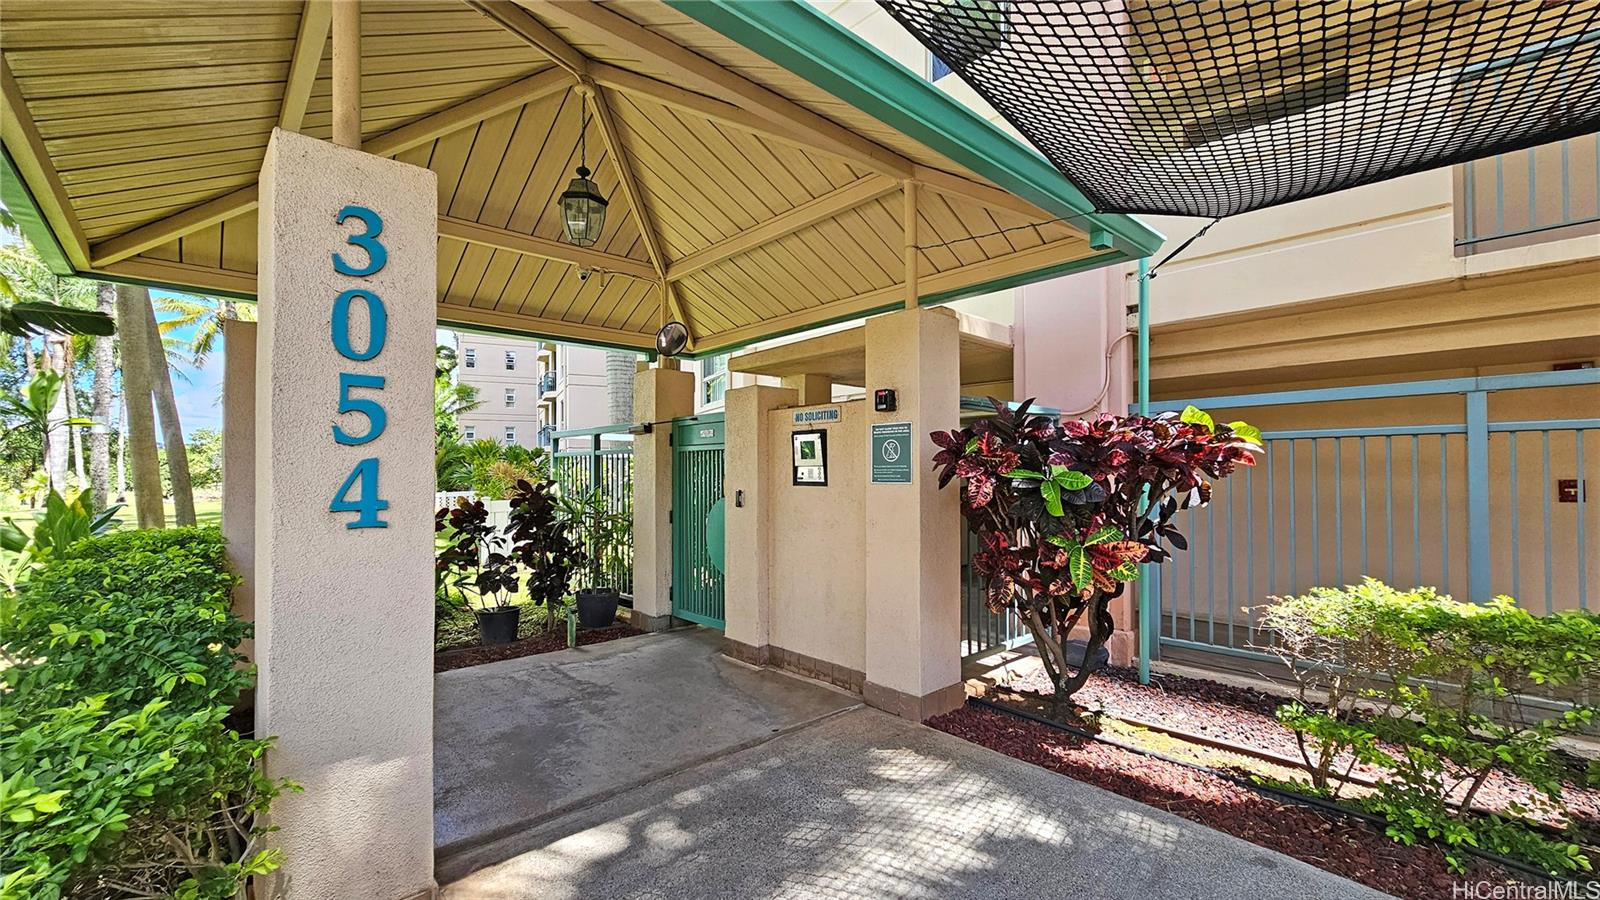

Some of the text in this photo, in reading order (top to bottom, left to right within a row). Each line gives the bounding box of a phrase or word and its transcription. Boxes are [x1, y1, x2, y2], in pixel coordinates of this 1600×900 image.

[330, 205, 390, 529] 3054
[795, 409, 838, 422] NO SOLICITING
